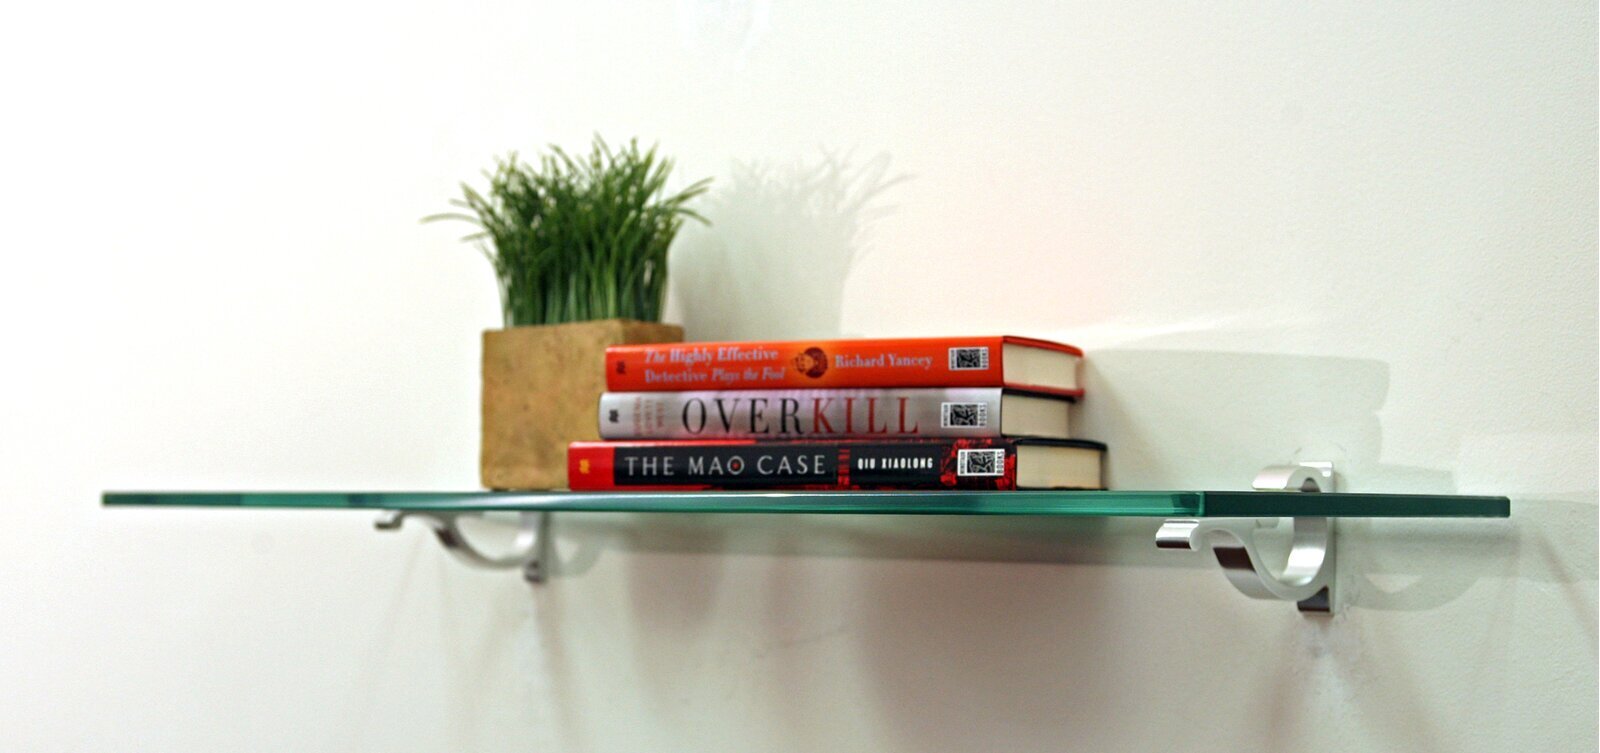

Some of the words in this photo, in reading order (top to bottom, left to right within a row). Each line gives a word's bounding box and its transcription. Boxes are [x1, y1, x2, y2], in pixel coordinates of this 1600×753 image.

[645, 350, 665, 364] The
[669, 349, 713, 366] Highly
[717, 347, 779, 362] Effective
[834, 354, 885, 368] Richard
[889, 354, 934, 370] Yancey
[645, 369, 707, 384] Detective
[711, 368, 740, 383] Plays
[743, 367, 759, 380] the
[762, 367, 785, 380] Fool
[682, 397, 919, 435] OVERKILL
[979, 404, 987, 427] BOOKS
[624, 457, 675, 477] THE
[688, 455, 745, 476] MAO
[757, 455, 826, 476] CASE
[857, 458, 876, 470] QIU
[881, 457, 934, 470] XIAOLONG
[996, 450, 1005, 474] BOOKS
